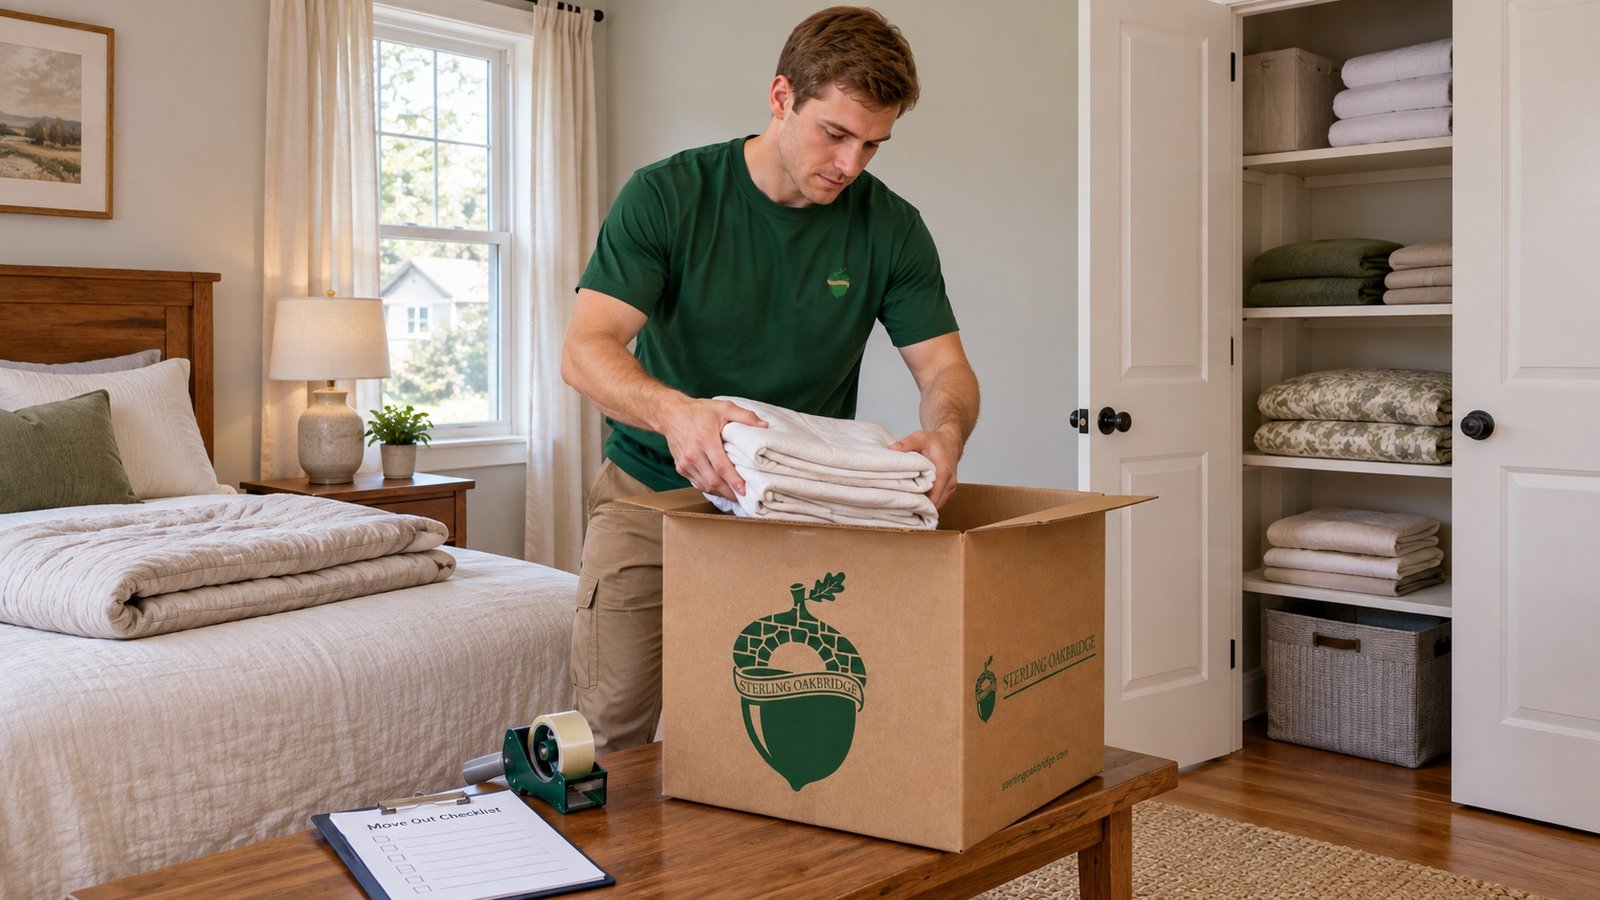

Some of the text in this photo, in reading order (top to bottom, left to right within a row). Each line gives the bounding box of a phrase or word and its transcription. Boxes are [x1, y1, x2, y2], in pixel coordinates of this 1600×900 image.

[1003, 634, 1097, 691] STERLING OAKBRIDGE
[739, 677, 857, 695] STERLING OAKBRIDGE
[367, 807, 502, 831] Move Out Checklist
